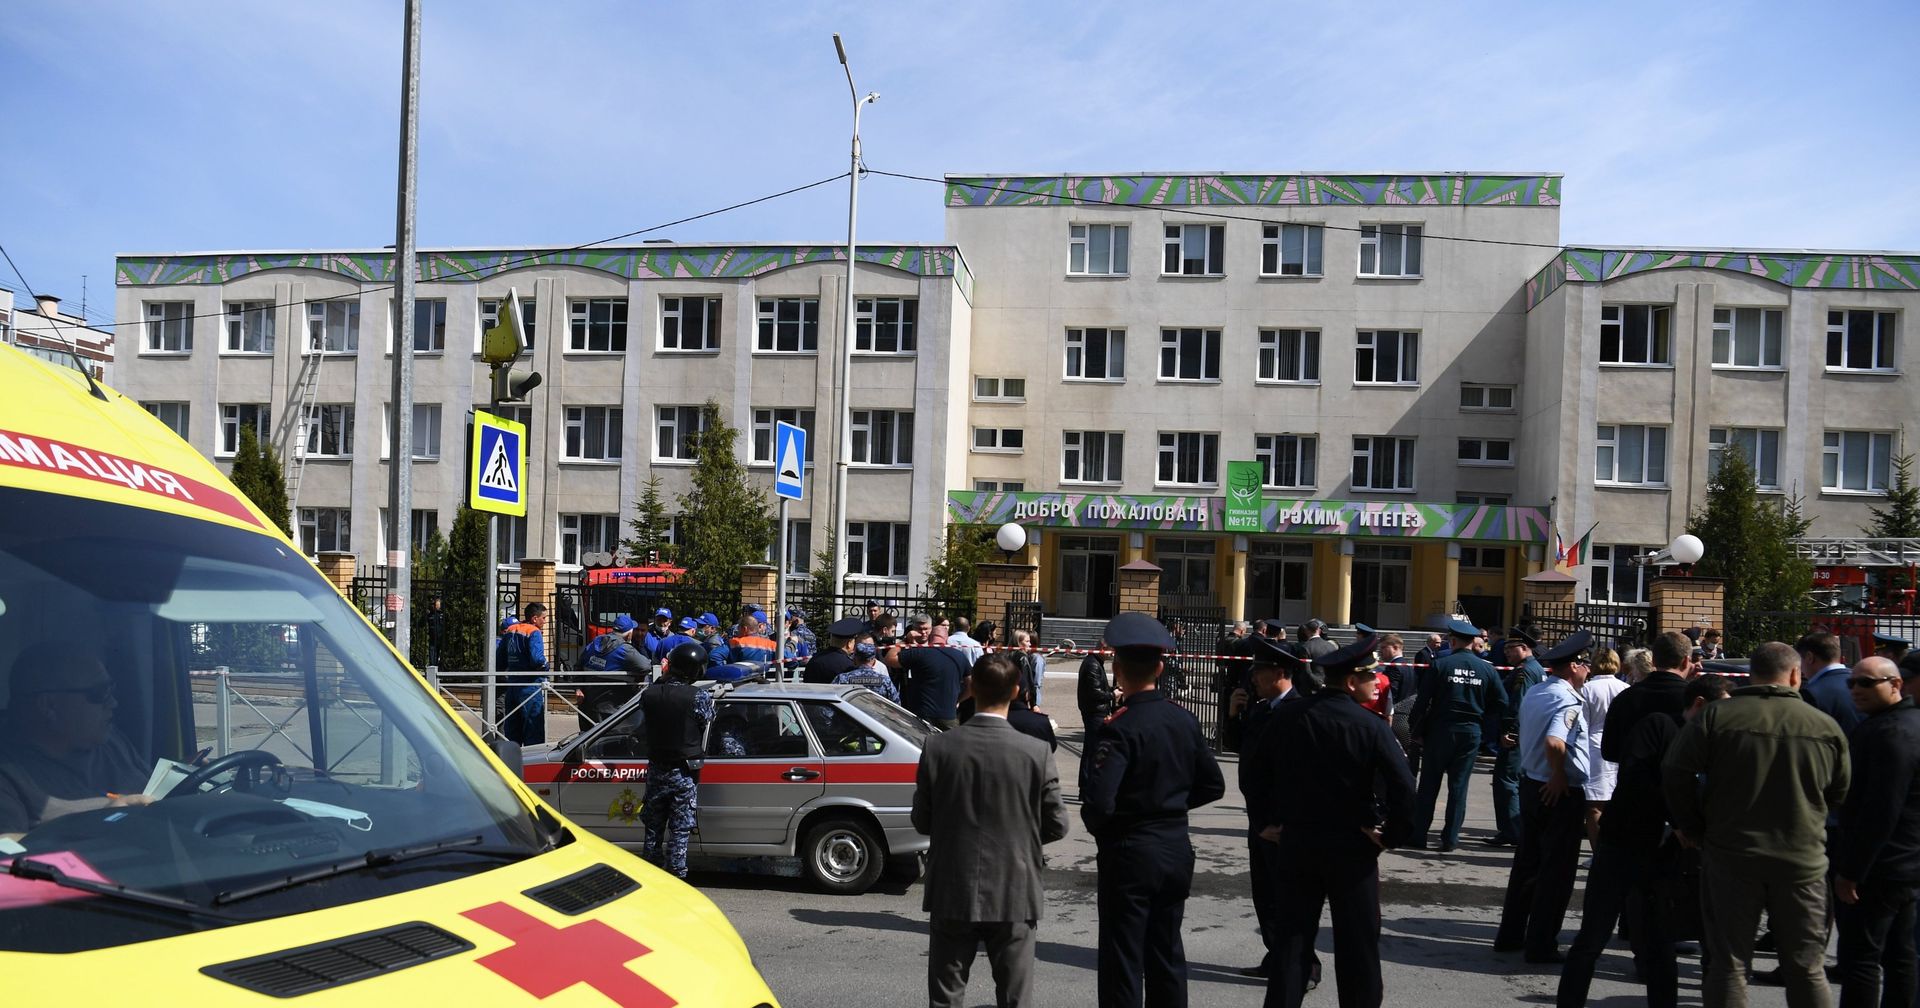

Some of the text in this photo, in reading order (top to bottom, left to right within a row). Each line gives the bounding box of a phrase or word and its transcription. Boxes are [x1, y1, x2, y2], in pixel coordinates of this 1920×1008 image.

[0, 434, 194, 501] МАЦИЯ
[1014, 501, 1208, 522] ДОБРО ПОЖАЛОВАТЬ
[1228, 516, 1258, 527] №175
[1279, 508, 1421, 528] РӘХИМ ИТЕГЕЗ
[1454, 668, 1475, 677] МЧС
[1447, 676, 1482, 686] РОССИИ
[570, 768, 648, 780] РОСГВАРДИ
